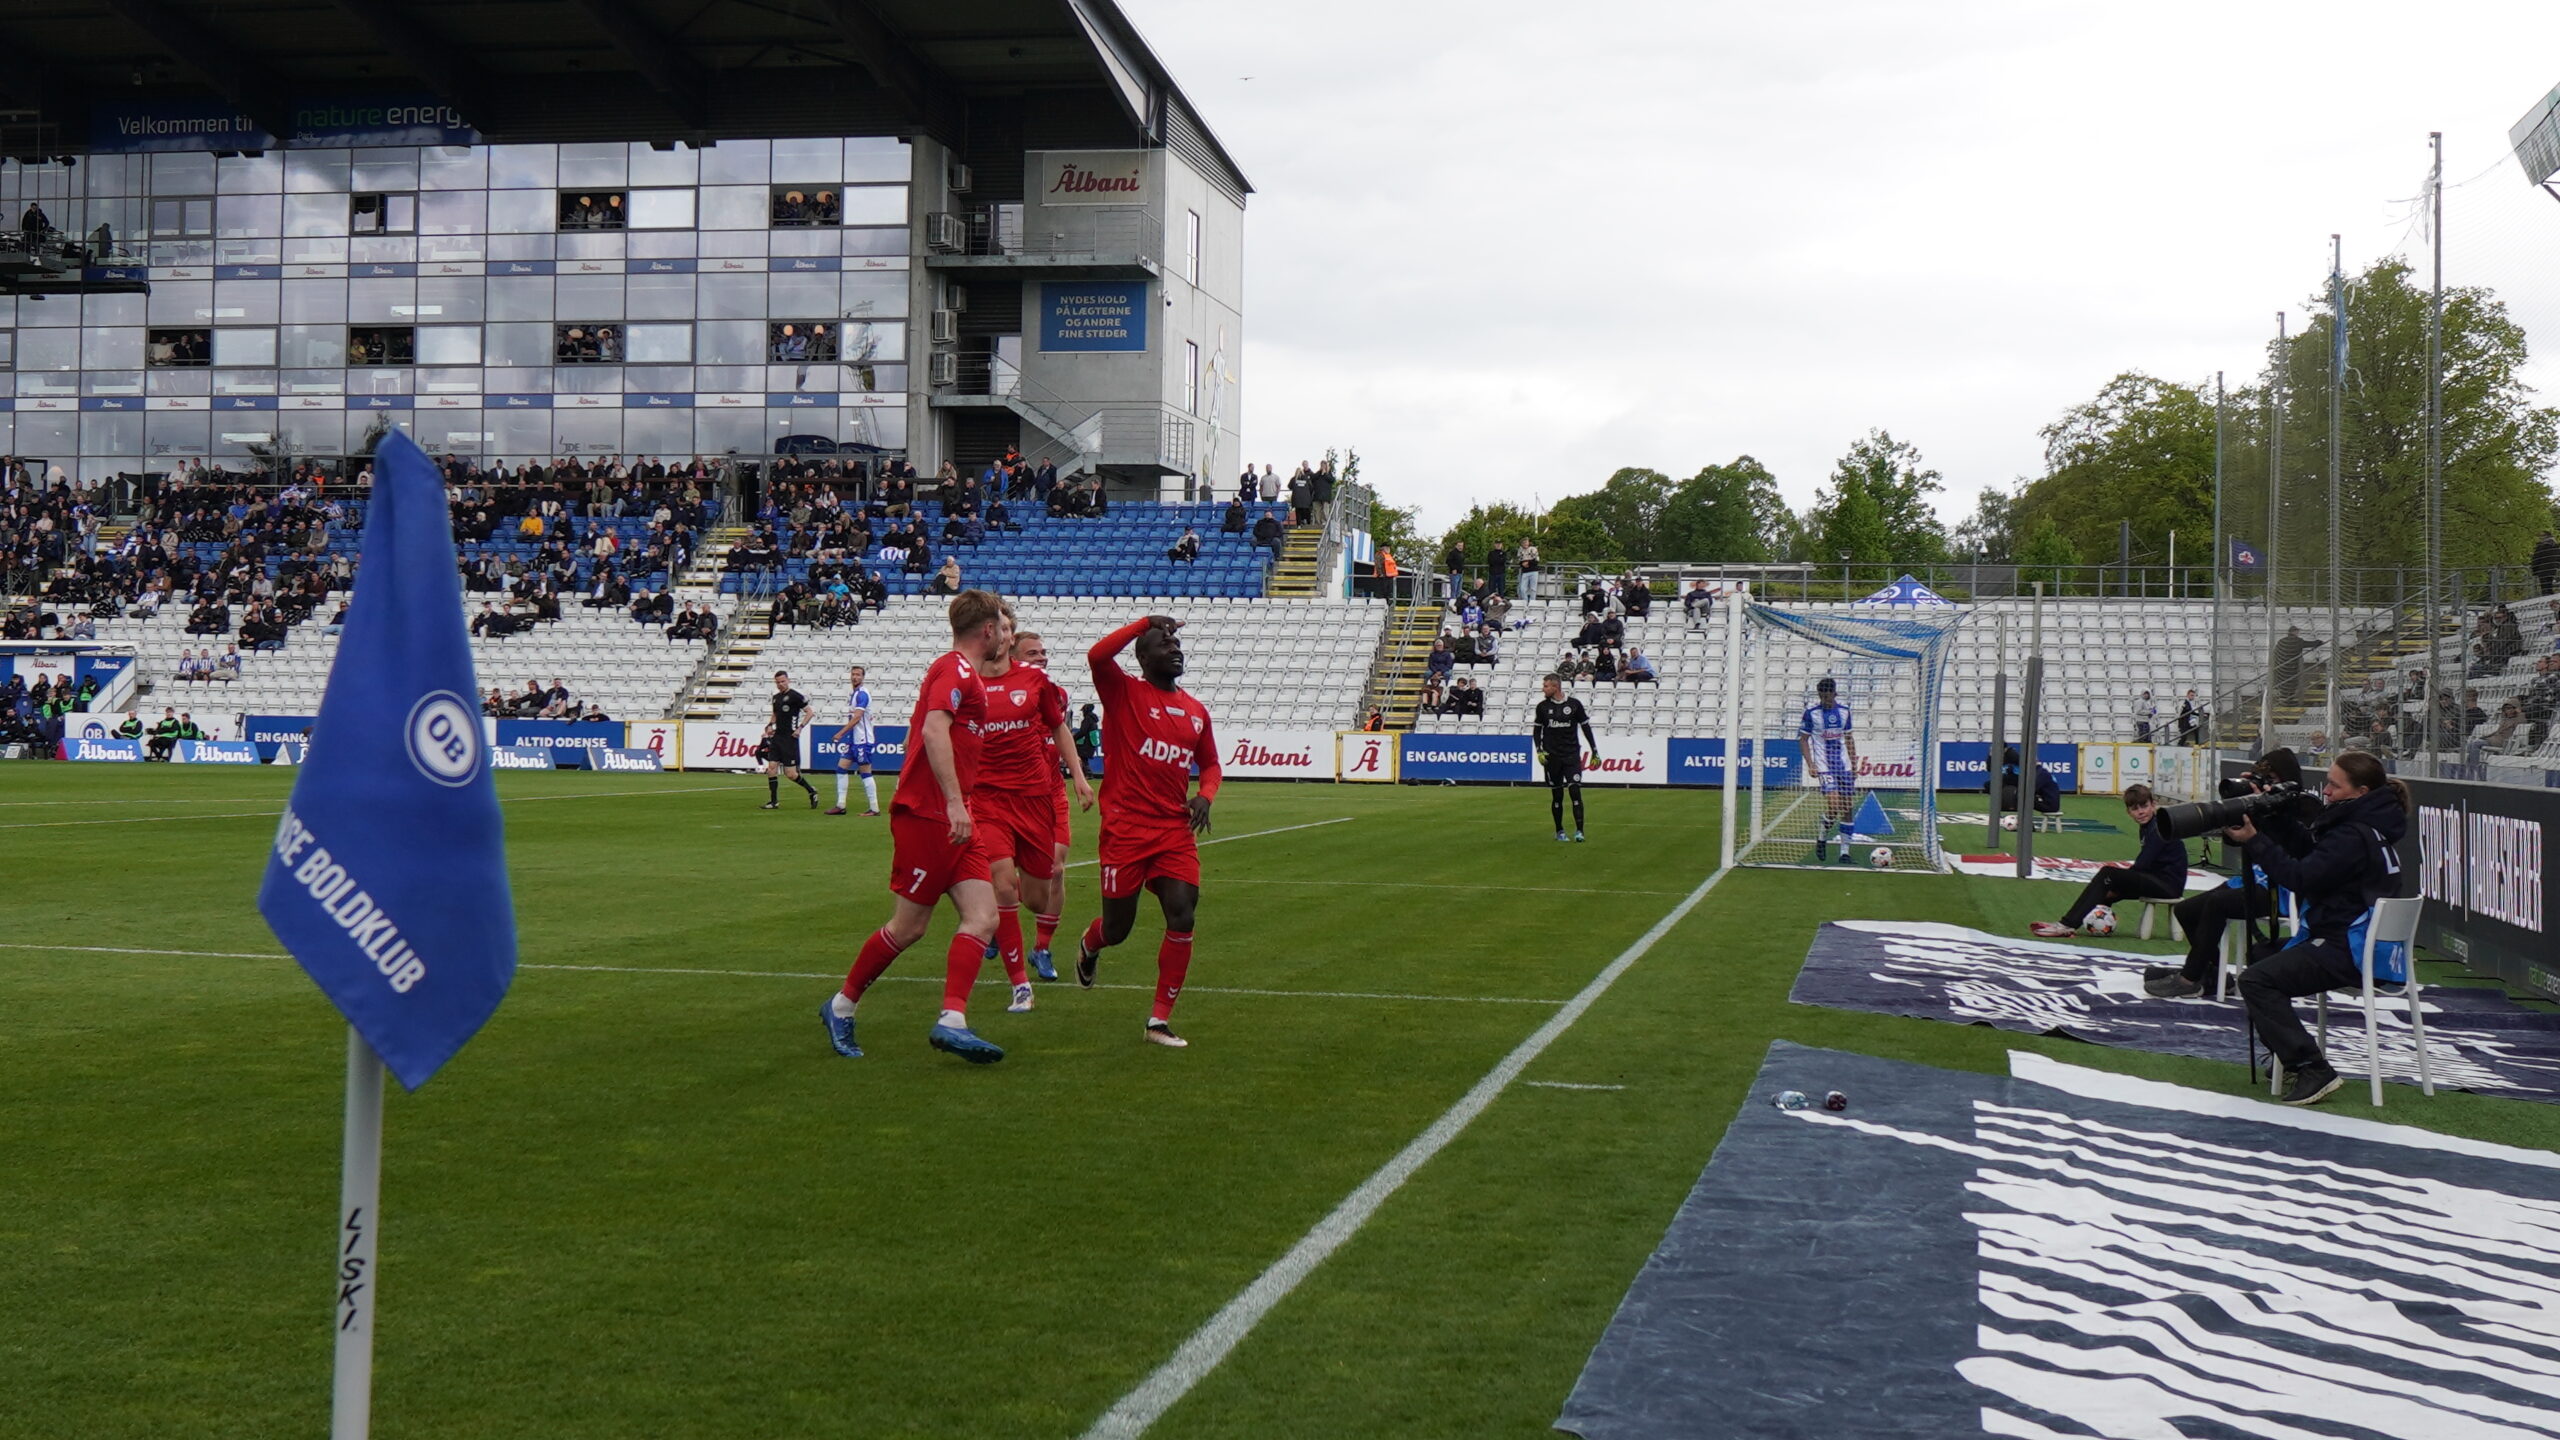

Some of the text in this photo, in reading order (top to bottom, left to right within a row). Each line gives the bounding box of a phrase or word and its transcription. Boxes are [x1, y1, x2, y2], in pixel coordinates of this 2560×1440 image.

[387, 107, 471, 129] energ
[119, 116, 229, 134] Velkommen
[1060, 296, 1127, 304] NYDES KOLD
[1056, 305, 1131, 315] PÅ LÆGTERNE
[1065, 318, 1121, 327] OG ANDRE
[1058, 330, 1128, 338] FINE STEDER
[85, 728, 103, 739] OB
[255, 732, 270, 742] EN
[428, 713, 466, 763] OB
[516, 736, 607, 748] ALTID ODENSE
[818, 743, 835, 754] EN
[1407, 751, 1527, 763] EN GANG ODENSE
[1946, 761, 1966, 771] EN
[2418, 805, 2442, 900] STOP
[910, 867, 927, 894] 7
[1104, 866, 1118, 893] 11
[294, 846, 427, 994] BOLDKLUB
[337, 1207, 366, 1331] LISKI
